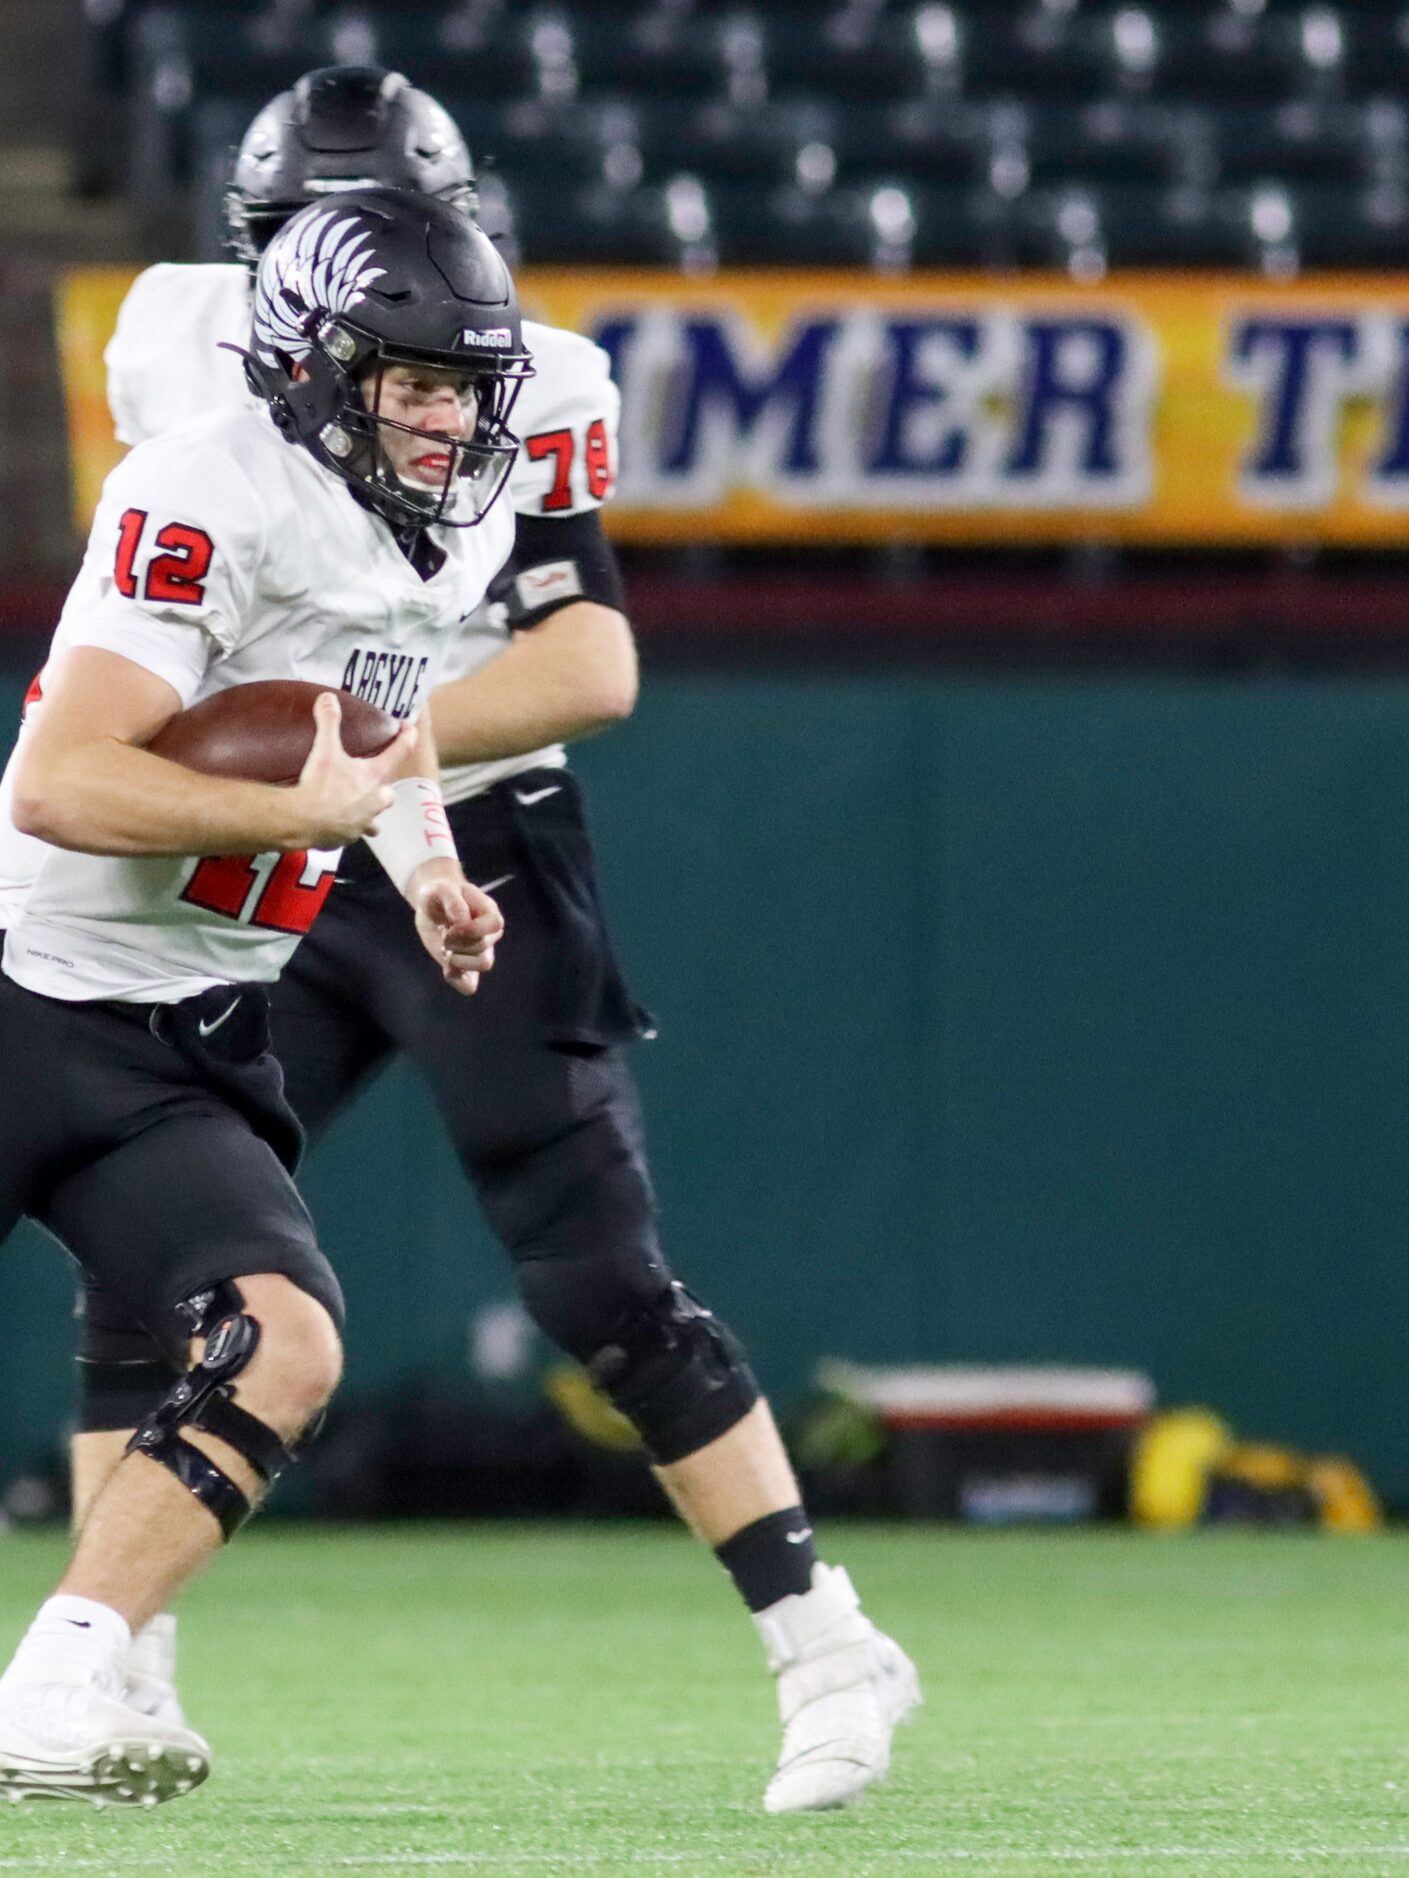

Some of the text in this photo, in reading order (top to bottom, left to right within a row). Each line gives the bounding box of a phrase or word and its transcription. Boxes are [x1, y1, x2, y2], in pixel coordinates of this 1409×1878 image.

[463, 328, 513, 349] Riddell
[596, 312, 1409, 492] MER T
[113, 507, 215, 606] 12
[342, 648, 429, 719] ARGYLE
